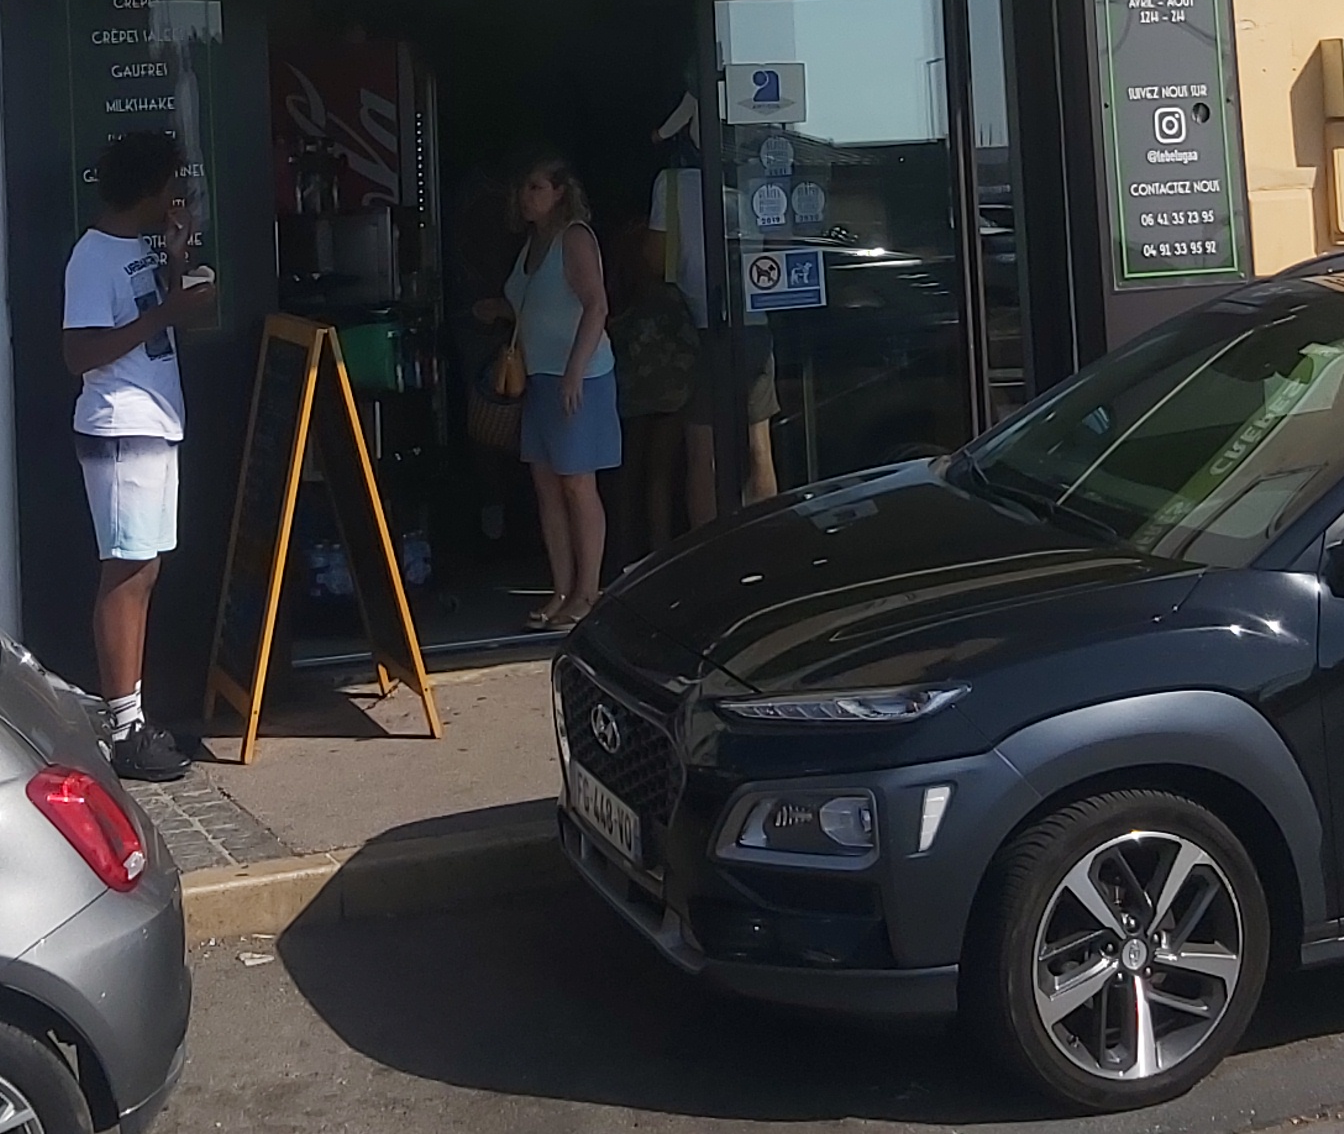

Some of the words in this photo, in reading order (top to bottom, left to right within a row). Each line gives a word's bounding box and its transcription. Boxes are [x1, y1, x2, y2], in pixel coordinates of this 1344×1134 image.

[111, 63, 168, 78] GAUFRES
[106, 96, 176, 112] MILKSHAKE
[1130, 181, 1192, 196] CONTACTEZ
[1193, 179, 1221, 193] NOUS
[1140, 213, 1154, 226] 06
[1156, 212, 1170, 225] 41
[1201, 209, 1214, 223] 95
[1143, 244, 1157, 257] 04
[1159, 243, 1172, 256] 91
[1174, 242, 1188, 255] 33
[1204, 240, 1217, 253] 92
